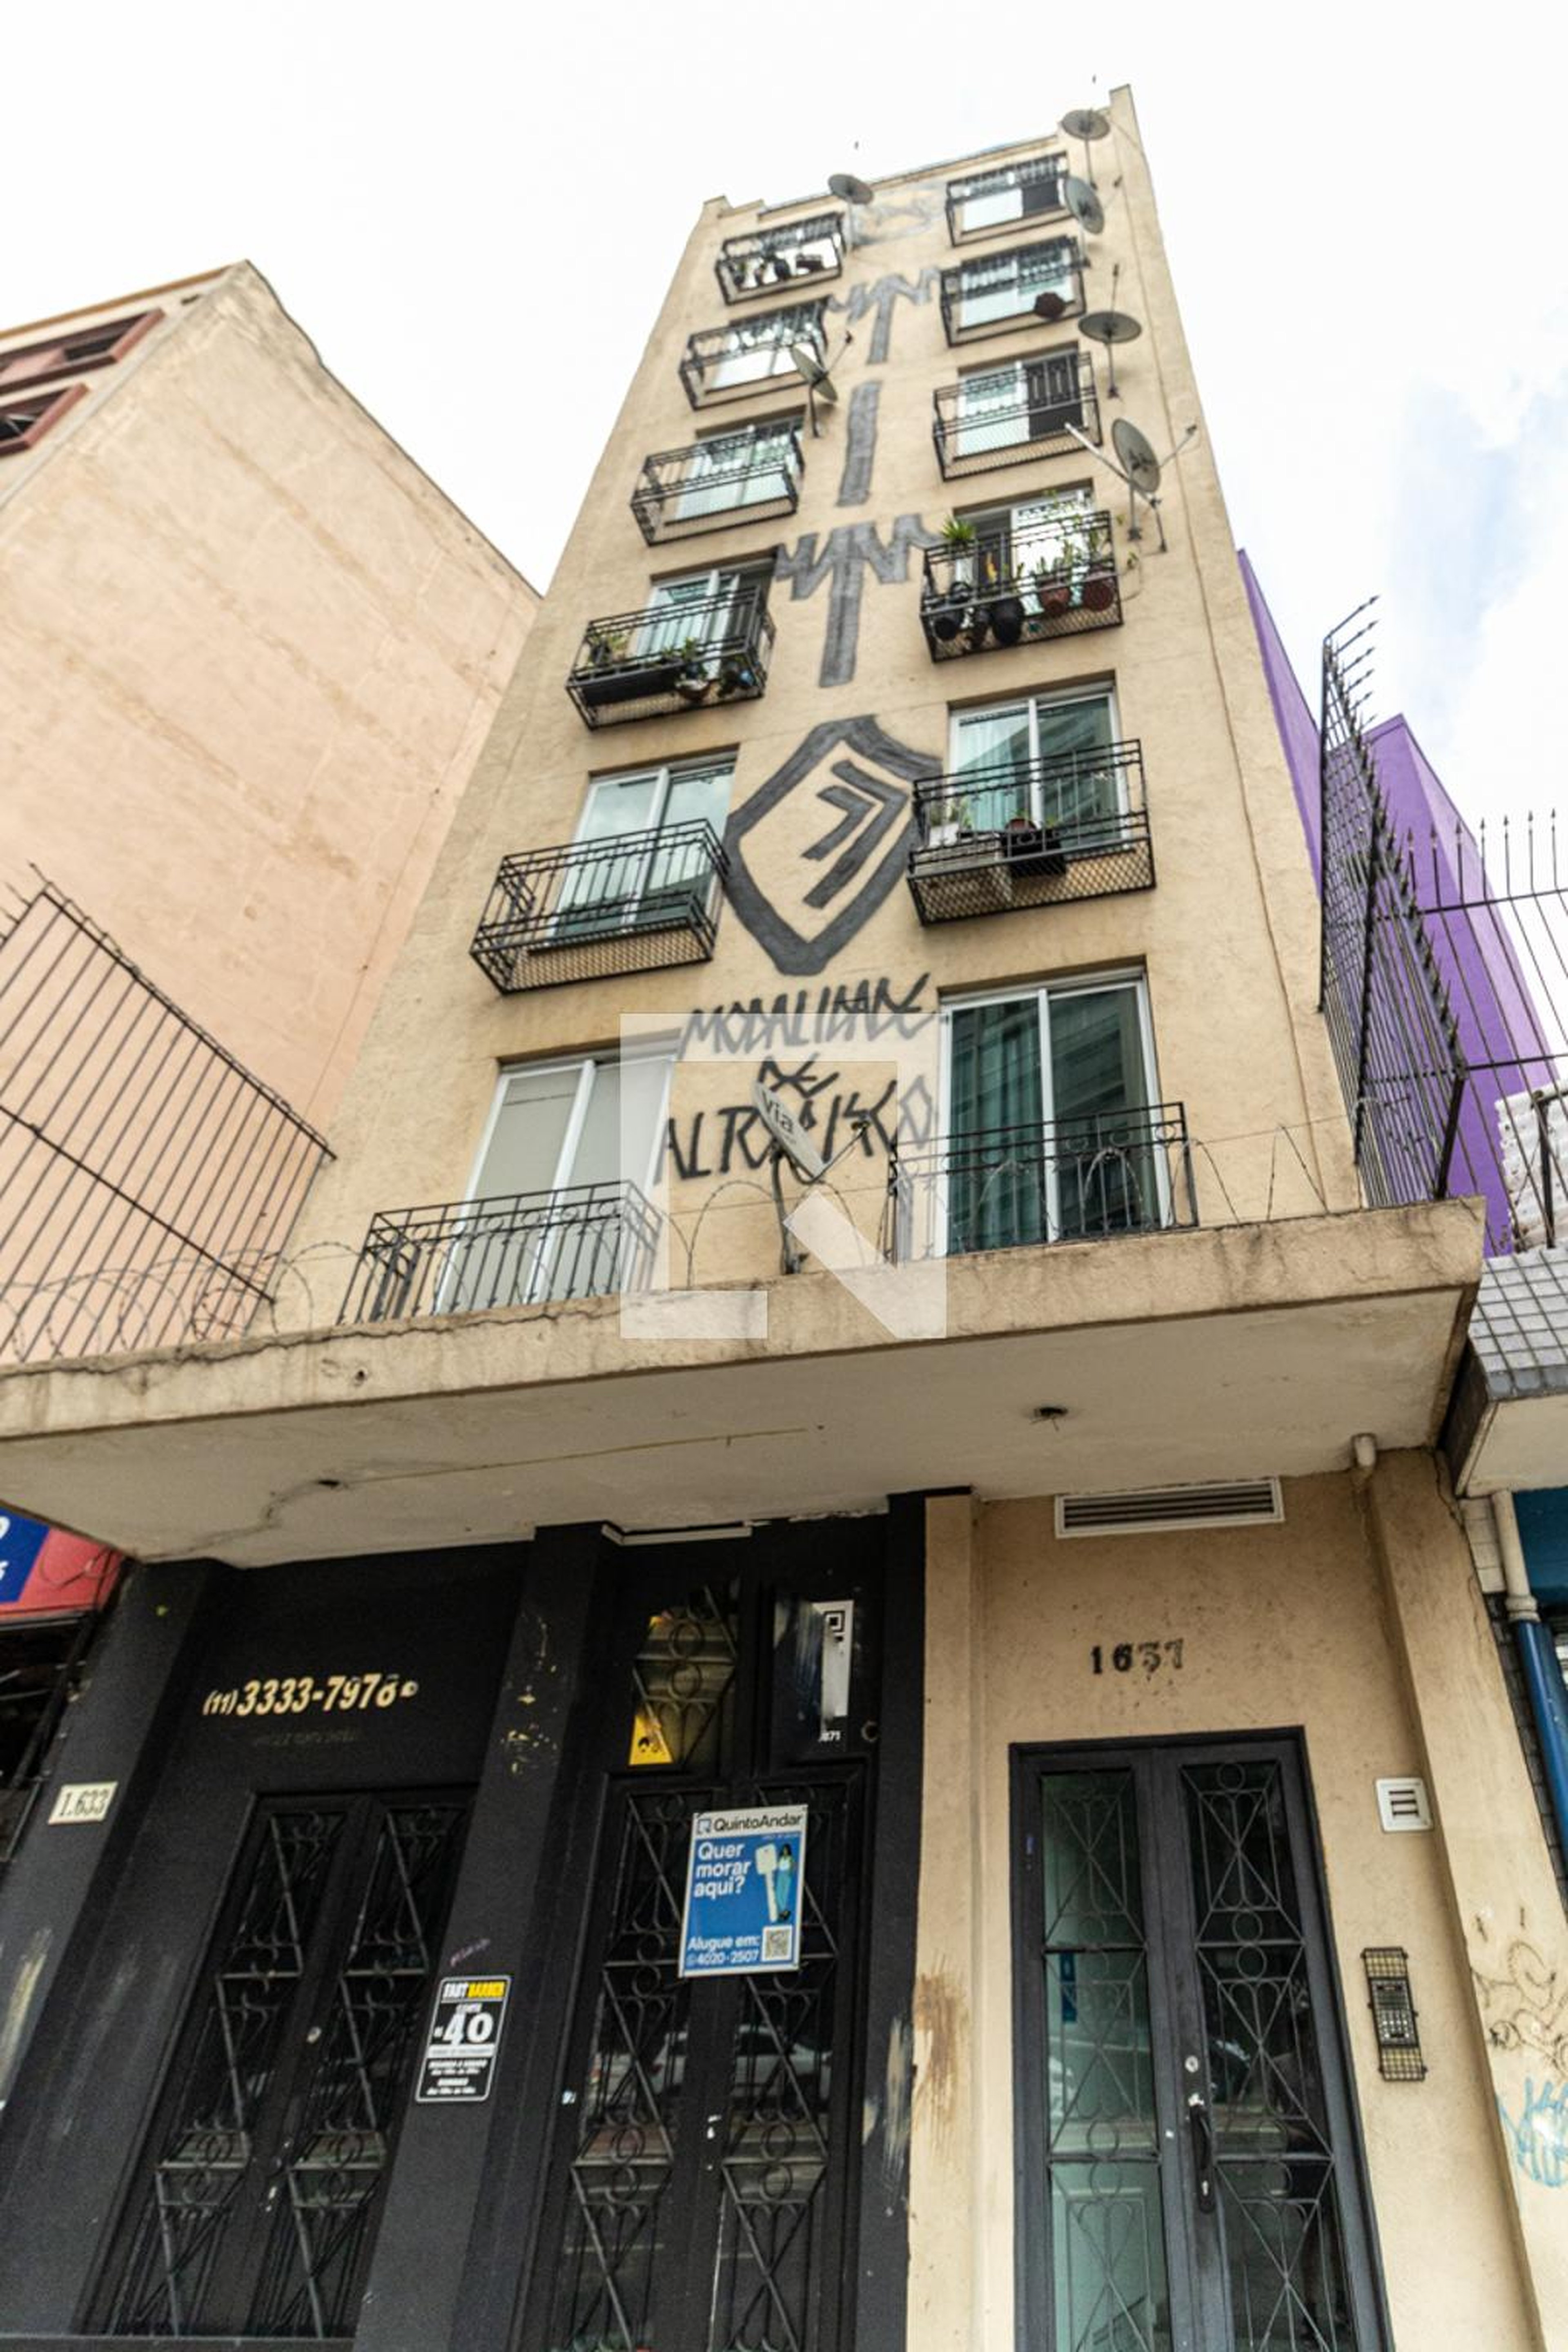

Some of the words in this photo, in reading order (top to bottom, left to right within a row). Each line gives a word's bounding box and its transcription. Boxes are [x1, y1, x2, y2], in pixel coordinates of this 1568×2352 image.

[1091, 1638, 1184, 1674] 1637
[714, 1813, 803, 1832] QuintoAndar
[698, 1842, 745, 1860] Quer
[696, 1861, 752, 1879] morar
[694, 1876, 746, 1901] aqui?
[688, 1936, 734, 1953] Alugue
[442, 2012, 494, 2045] 40
